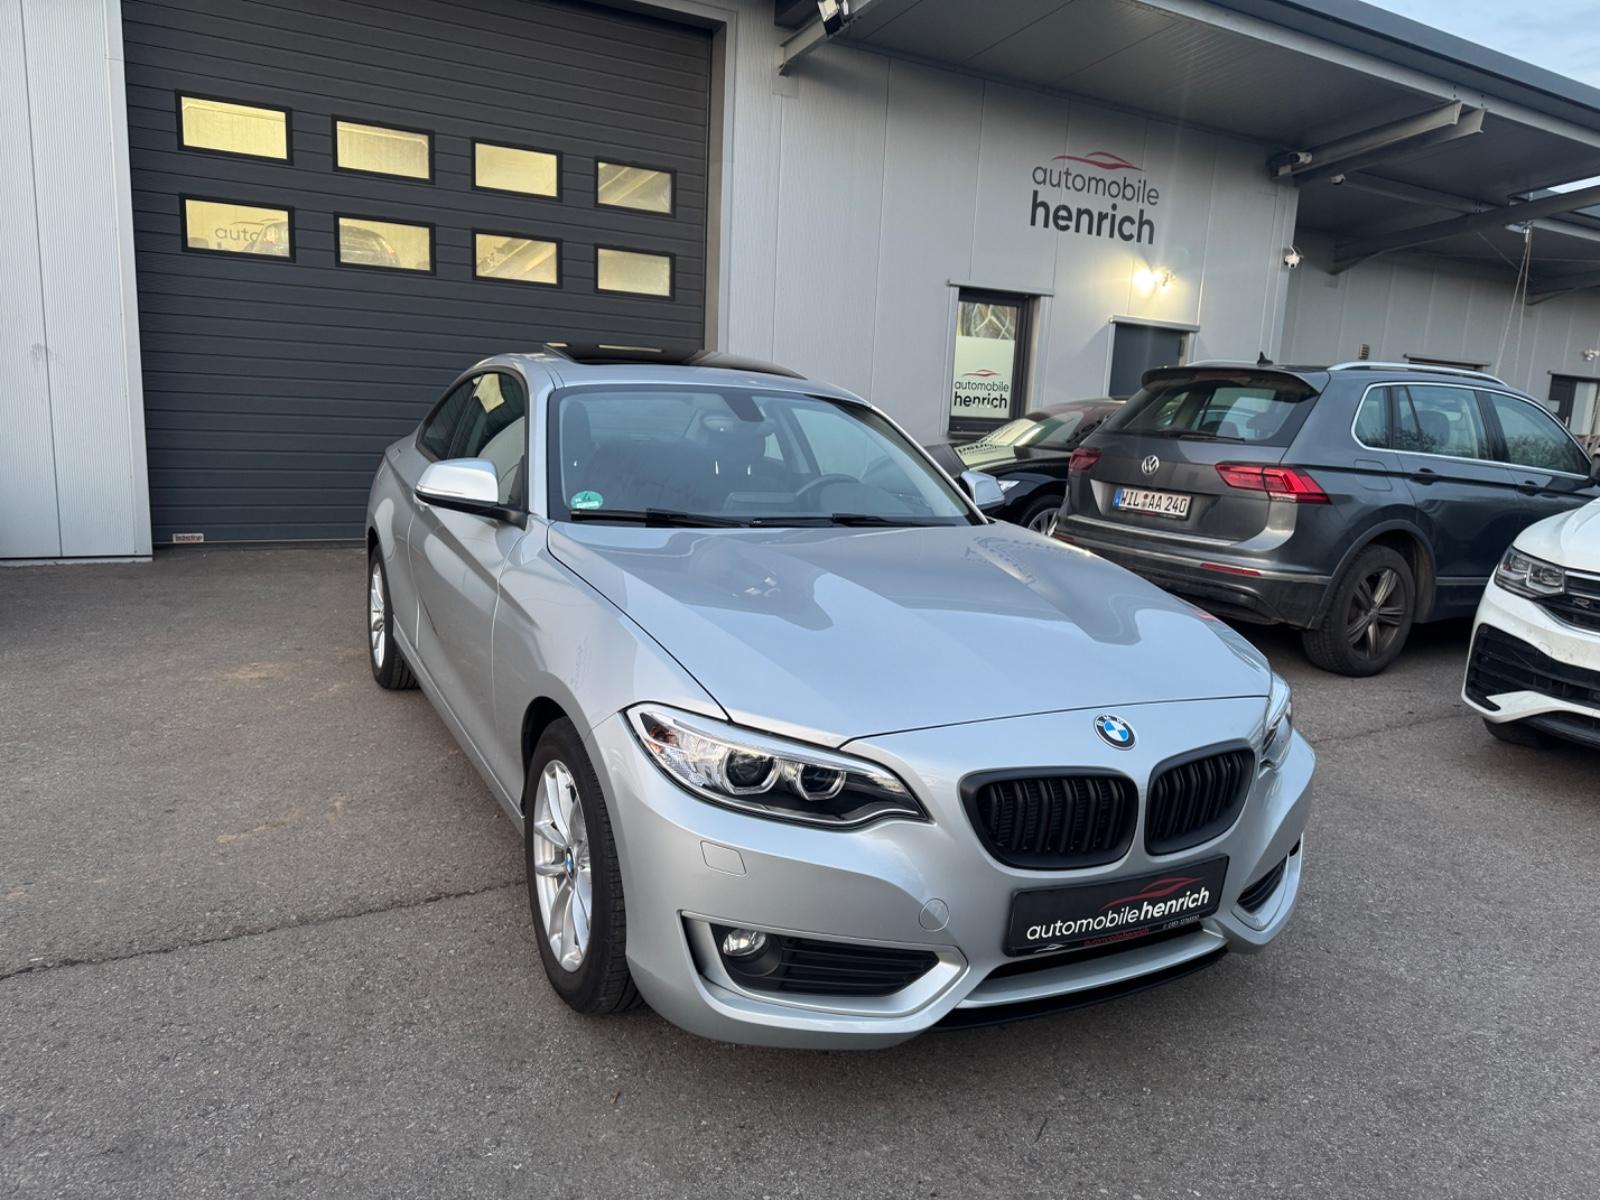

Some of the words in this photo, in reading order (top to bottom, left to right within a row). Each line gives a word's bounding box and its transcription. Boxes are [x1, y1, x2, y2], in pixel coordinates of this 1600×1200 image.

[1032, 166, 1159, 206] automobile
[1030, 189, 1155, 245] henrich
[954, 380, 1010, 393] automobile
[953, 391, 1008, 409] henrich
[1164, 496, 1188, 514] 240
